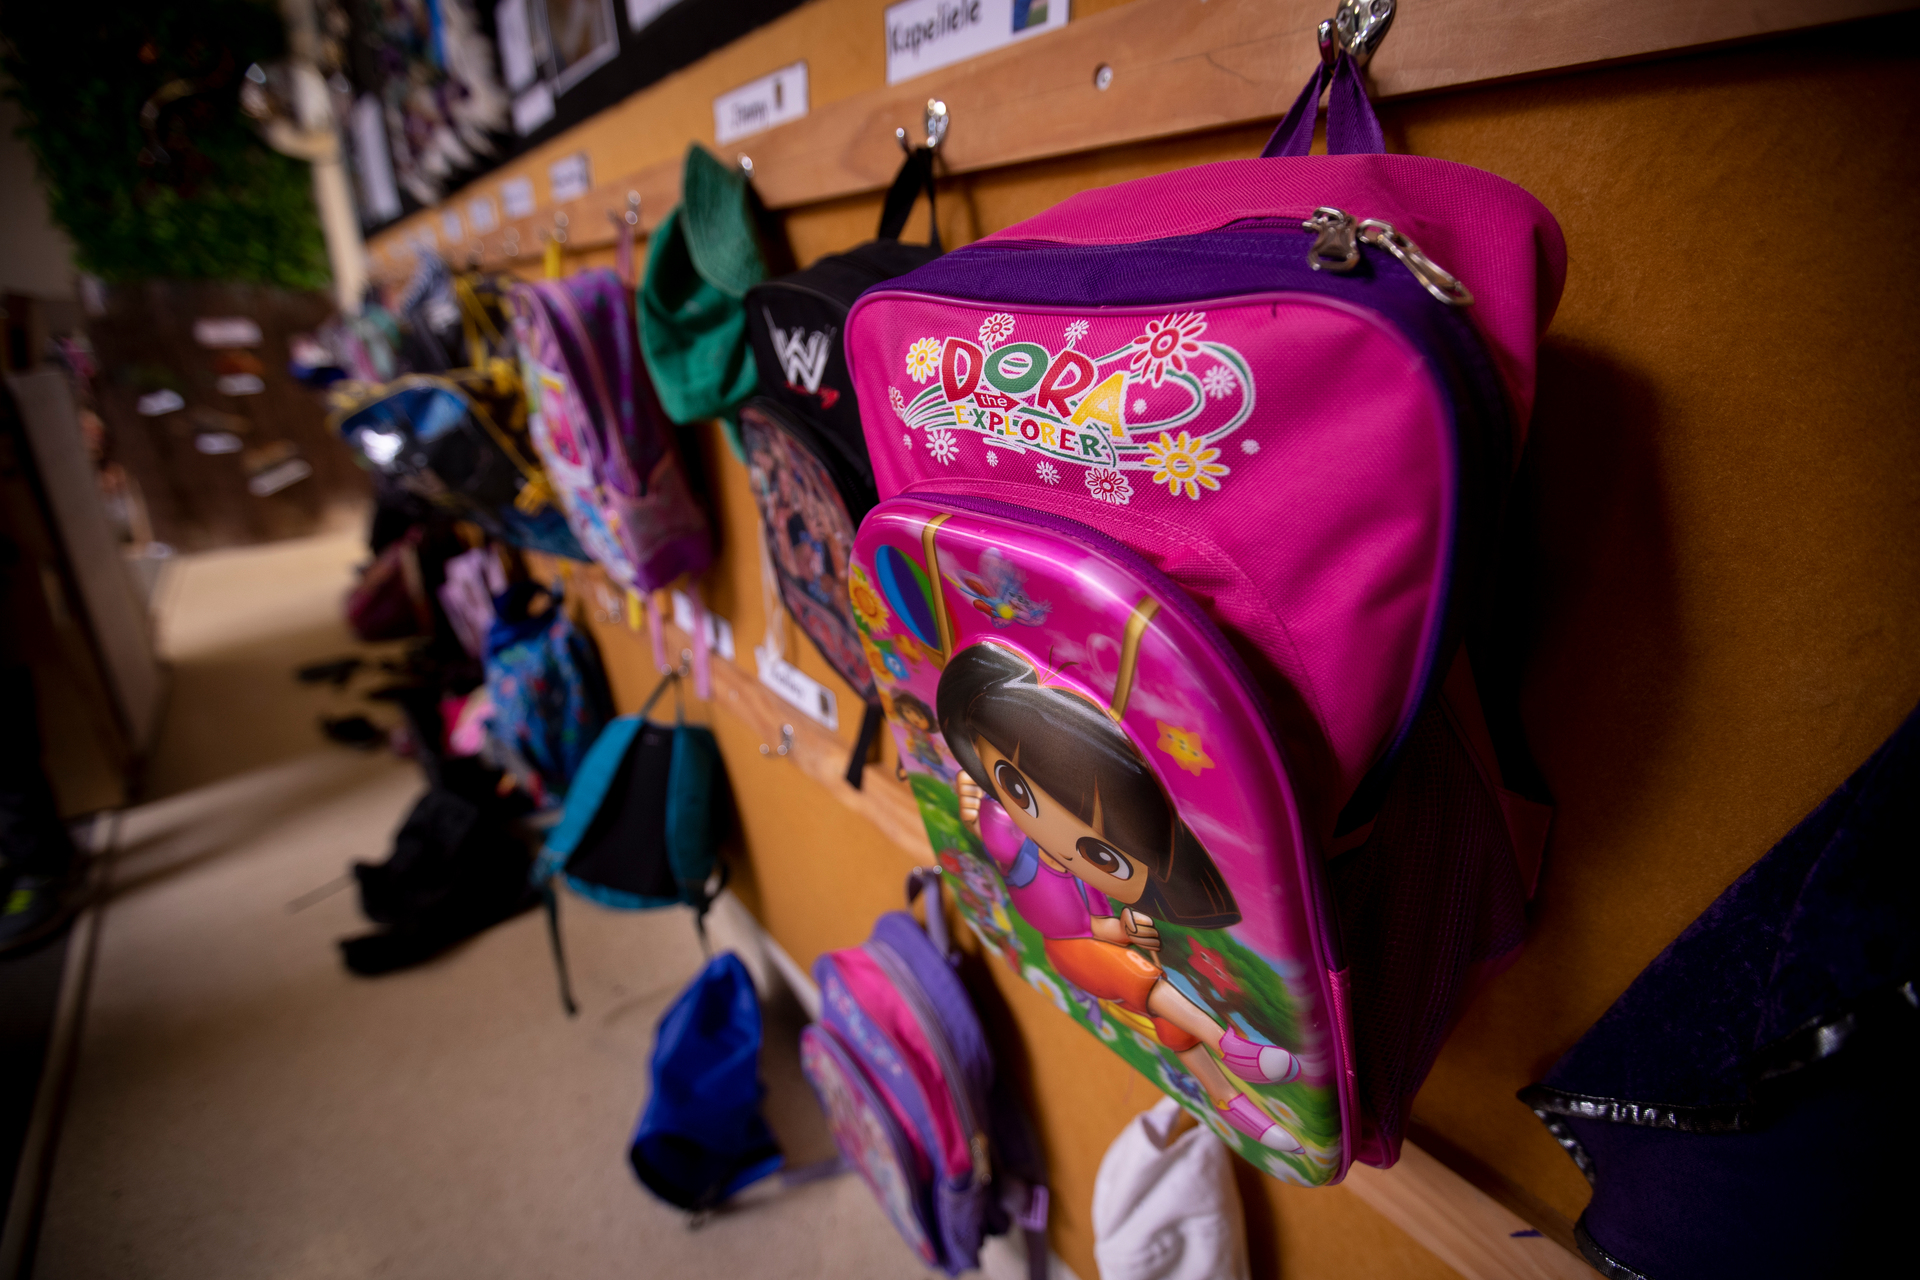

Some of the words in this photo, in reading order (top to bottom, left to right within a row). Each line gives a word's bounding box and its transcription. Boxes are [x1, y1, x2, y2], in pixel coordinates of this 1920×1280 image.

[940, 337, 1130, 439] DORA
[979, 393, 1008, 409] the
[954, 404, 1103, 459] EXPLORER
